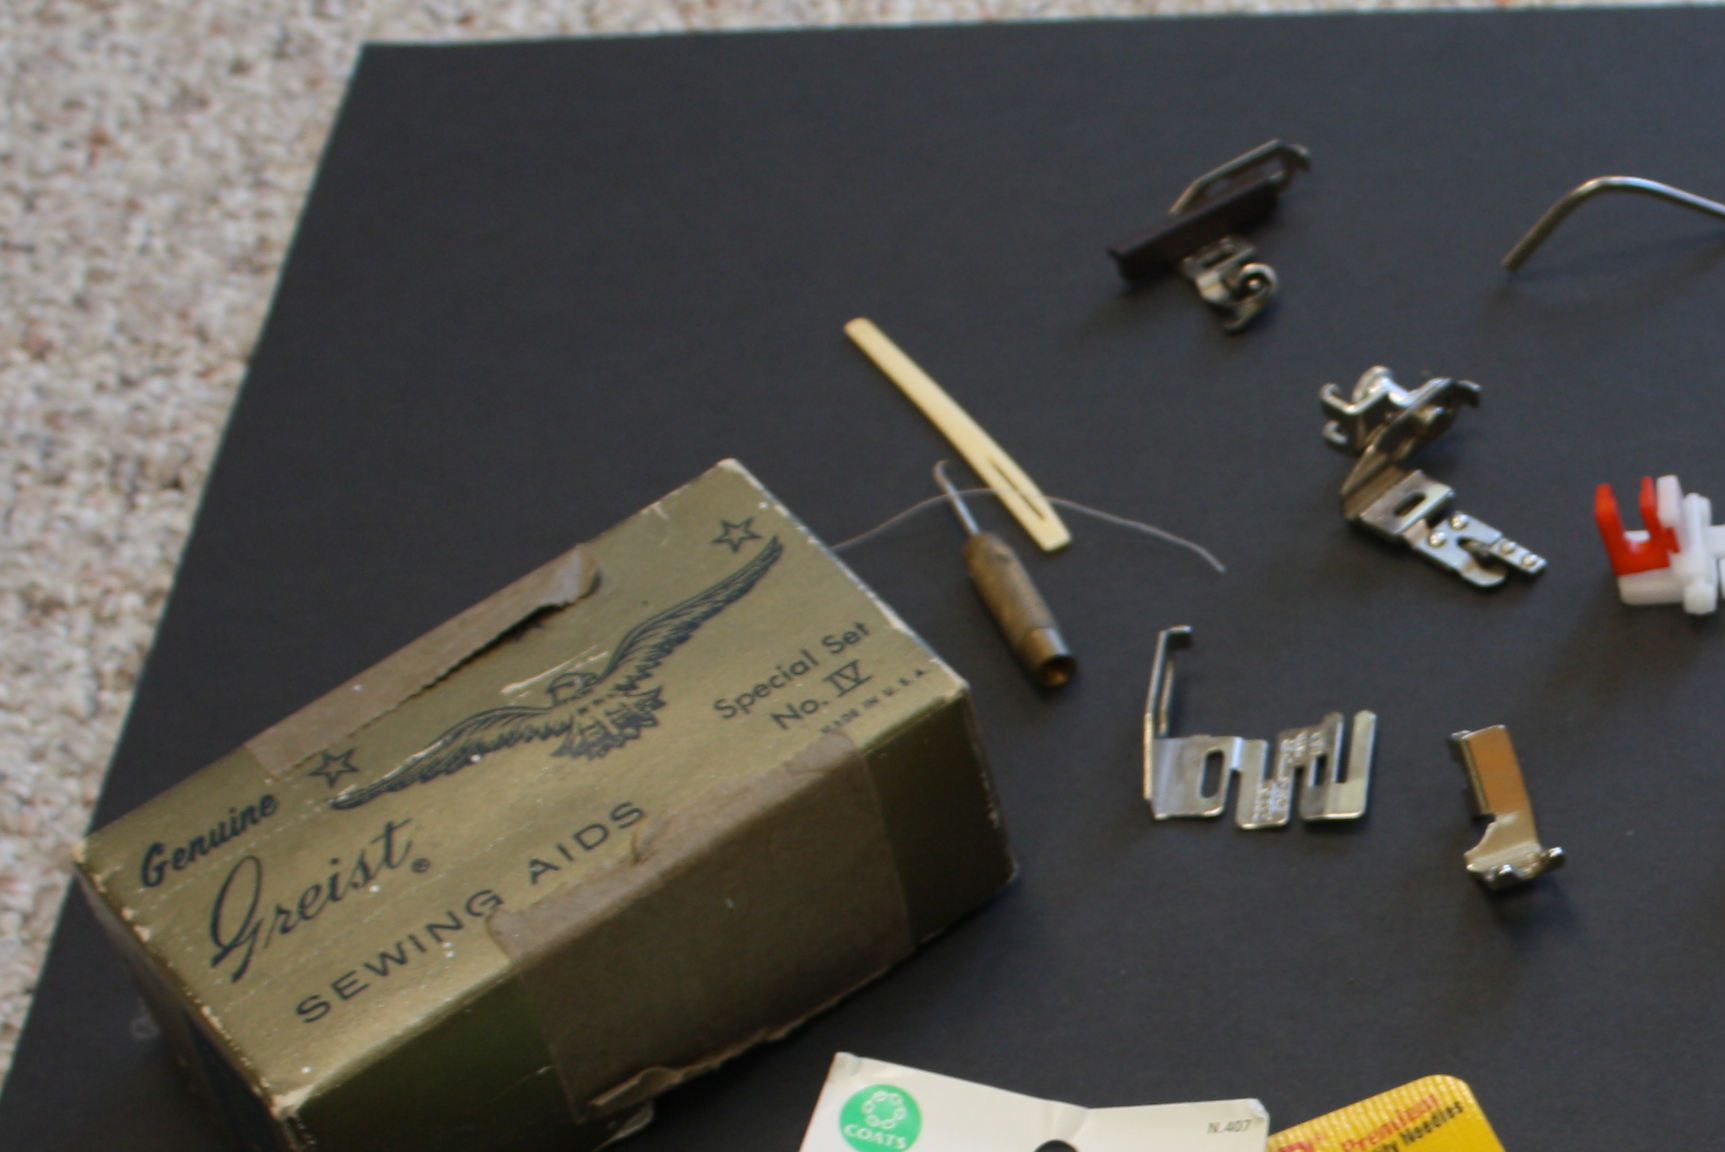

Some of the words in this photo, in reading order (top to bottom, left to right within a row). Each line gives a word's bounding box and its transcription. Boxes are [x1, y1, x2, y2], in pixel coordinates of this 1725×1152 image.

[713, 648, 820, 720] Special
[821, 622, 870, 655] Set
[769, 699, 830, 731] No.
[822, 659, 873, 698] IV
[139, 793, 279, 888] Genuine
[210, 819, 411, 981] Greist
[294, 889, 504, 1024] SEWING
[528, 801, 647, 885] AIDS
[842, 1123, 908, 1151] COATS
[1401, 1100, 1464, 1146] Needles
